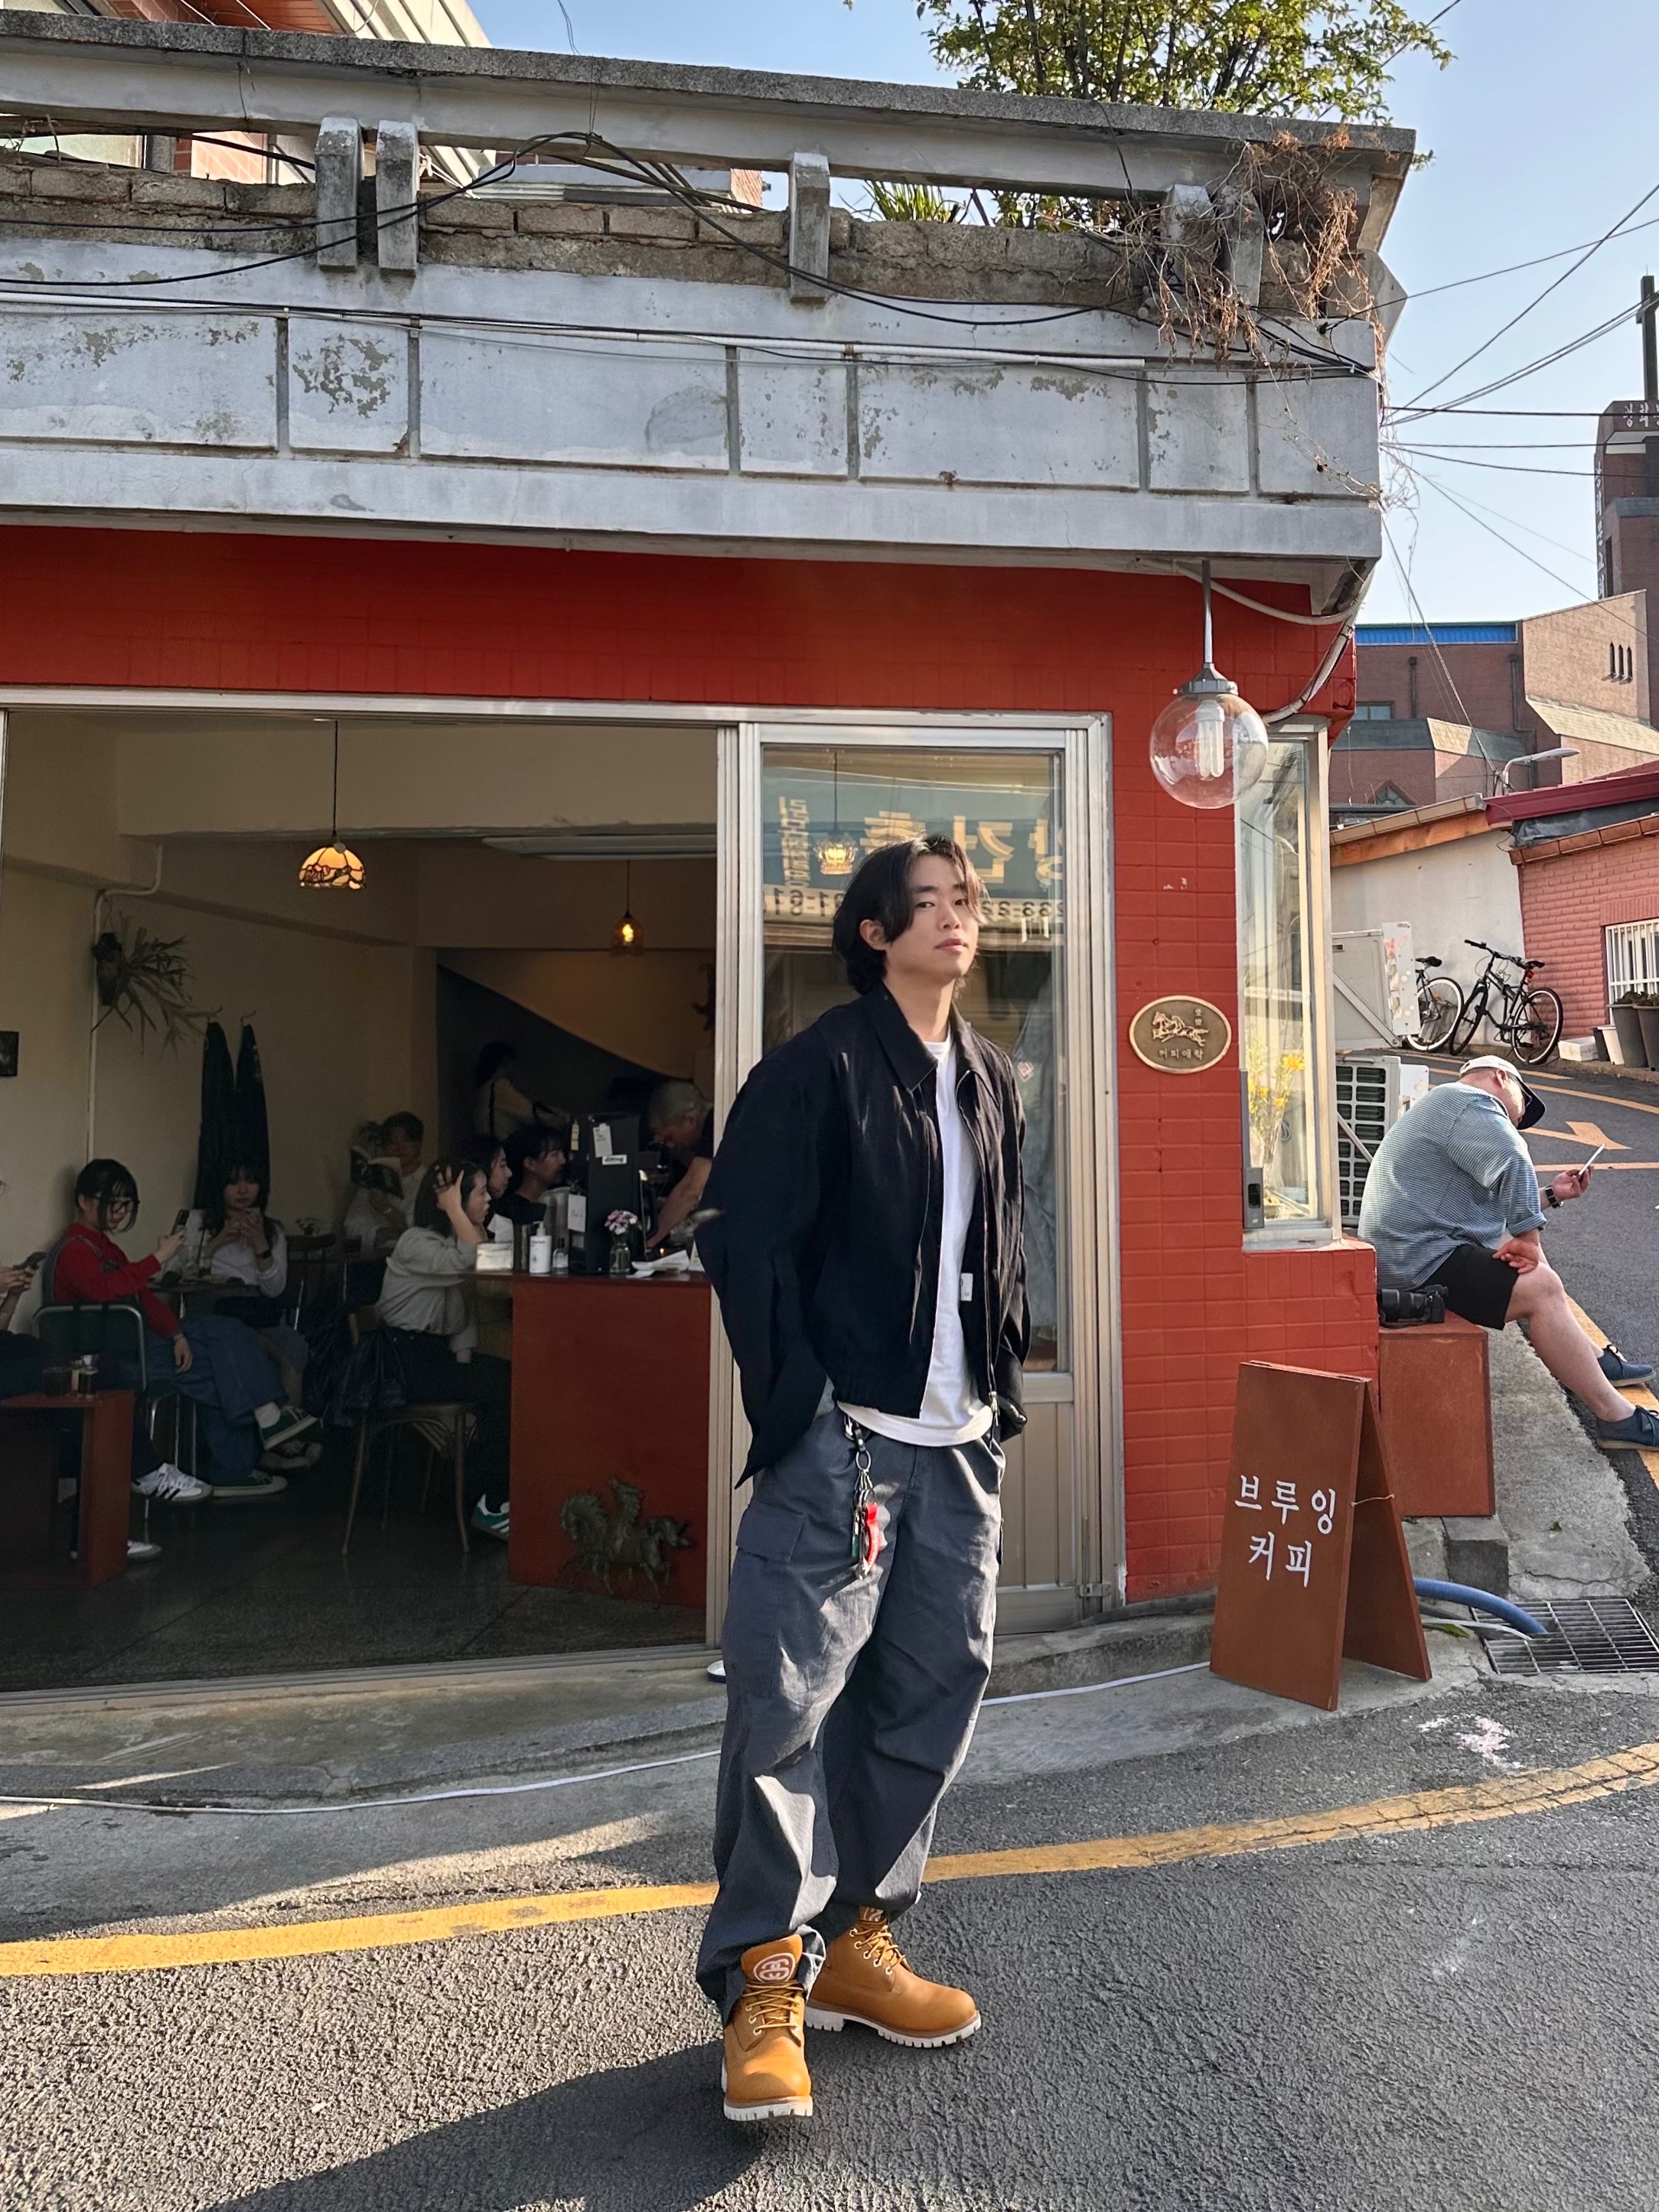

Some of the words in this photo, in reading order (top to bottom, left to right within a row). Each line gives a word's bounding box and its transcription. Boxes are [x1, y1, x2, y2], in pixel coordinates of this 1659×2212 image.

[1159, 1048, 1204, 1060] 커피애락
[1234, 1475, 1336, 1534] 브루잉
[1248, 1531, 1312, 1588] 커피
